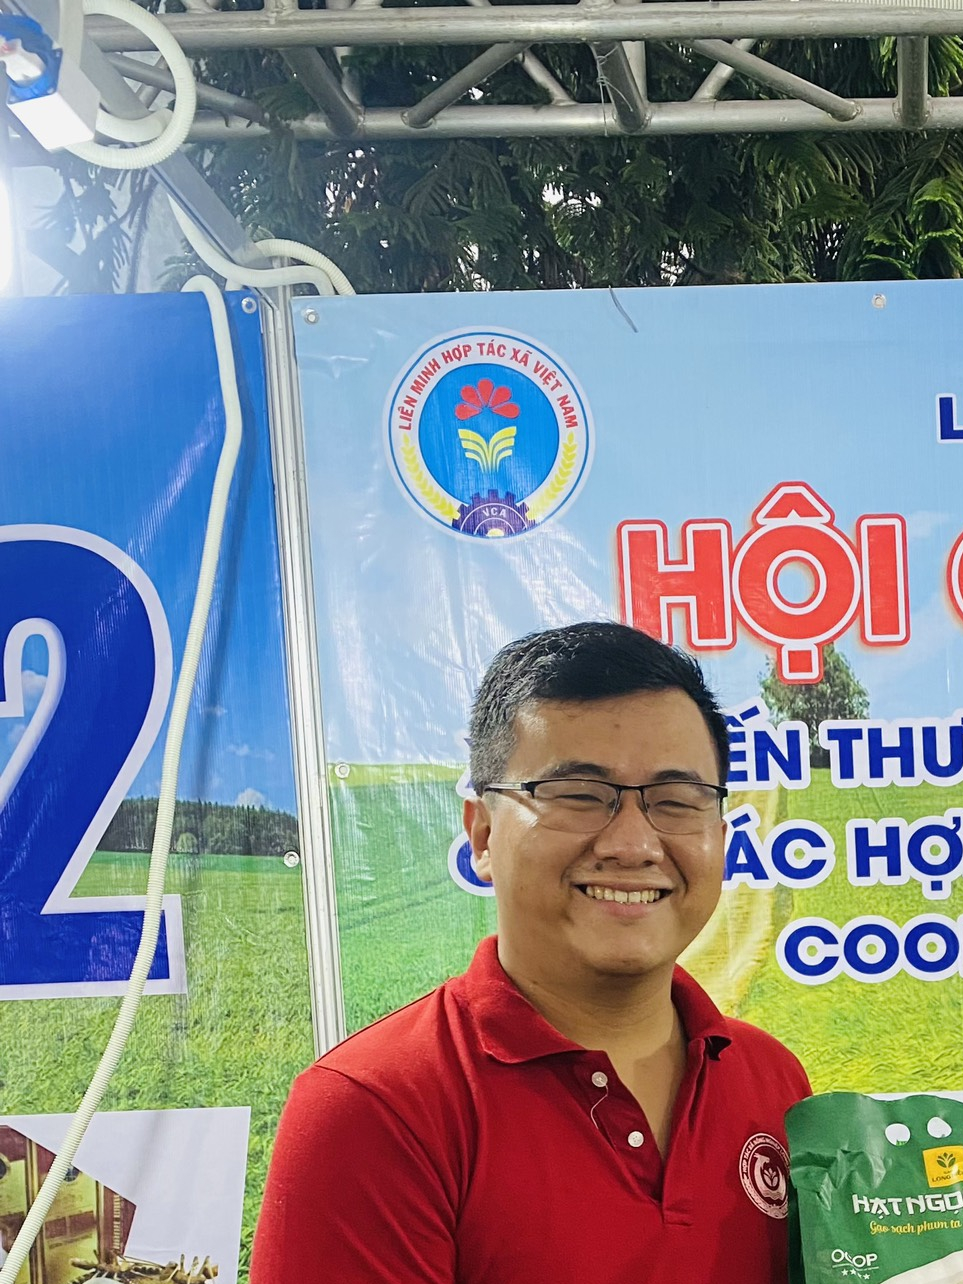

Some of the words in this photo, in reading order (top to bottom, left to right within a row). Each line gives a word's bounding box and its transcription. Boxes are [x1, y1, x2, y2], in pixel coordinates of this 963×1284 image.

[395, 392, 419, 432] LIÊN
[410, 358, 441, 396] MINH
[441, 344, 472, 364] HỢP
[476, 338, 507, 358] TÁC
[510, 347, 533, 367] XÃ
[532, 360, 563, 392] VIỆT
[556, 394, 579, 429] NAM
[482, 506, 507, 518] VCA
[619, 481, 911, 685] HỘI
[723, 812, 828, 880] ÁC
[852, 1193, 903, 1220] HẠT
